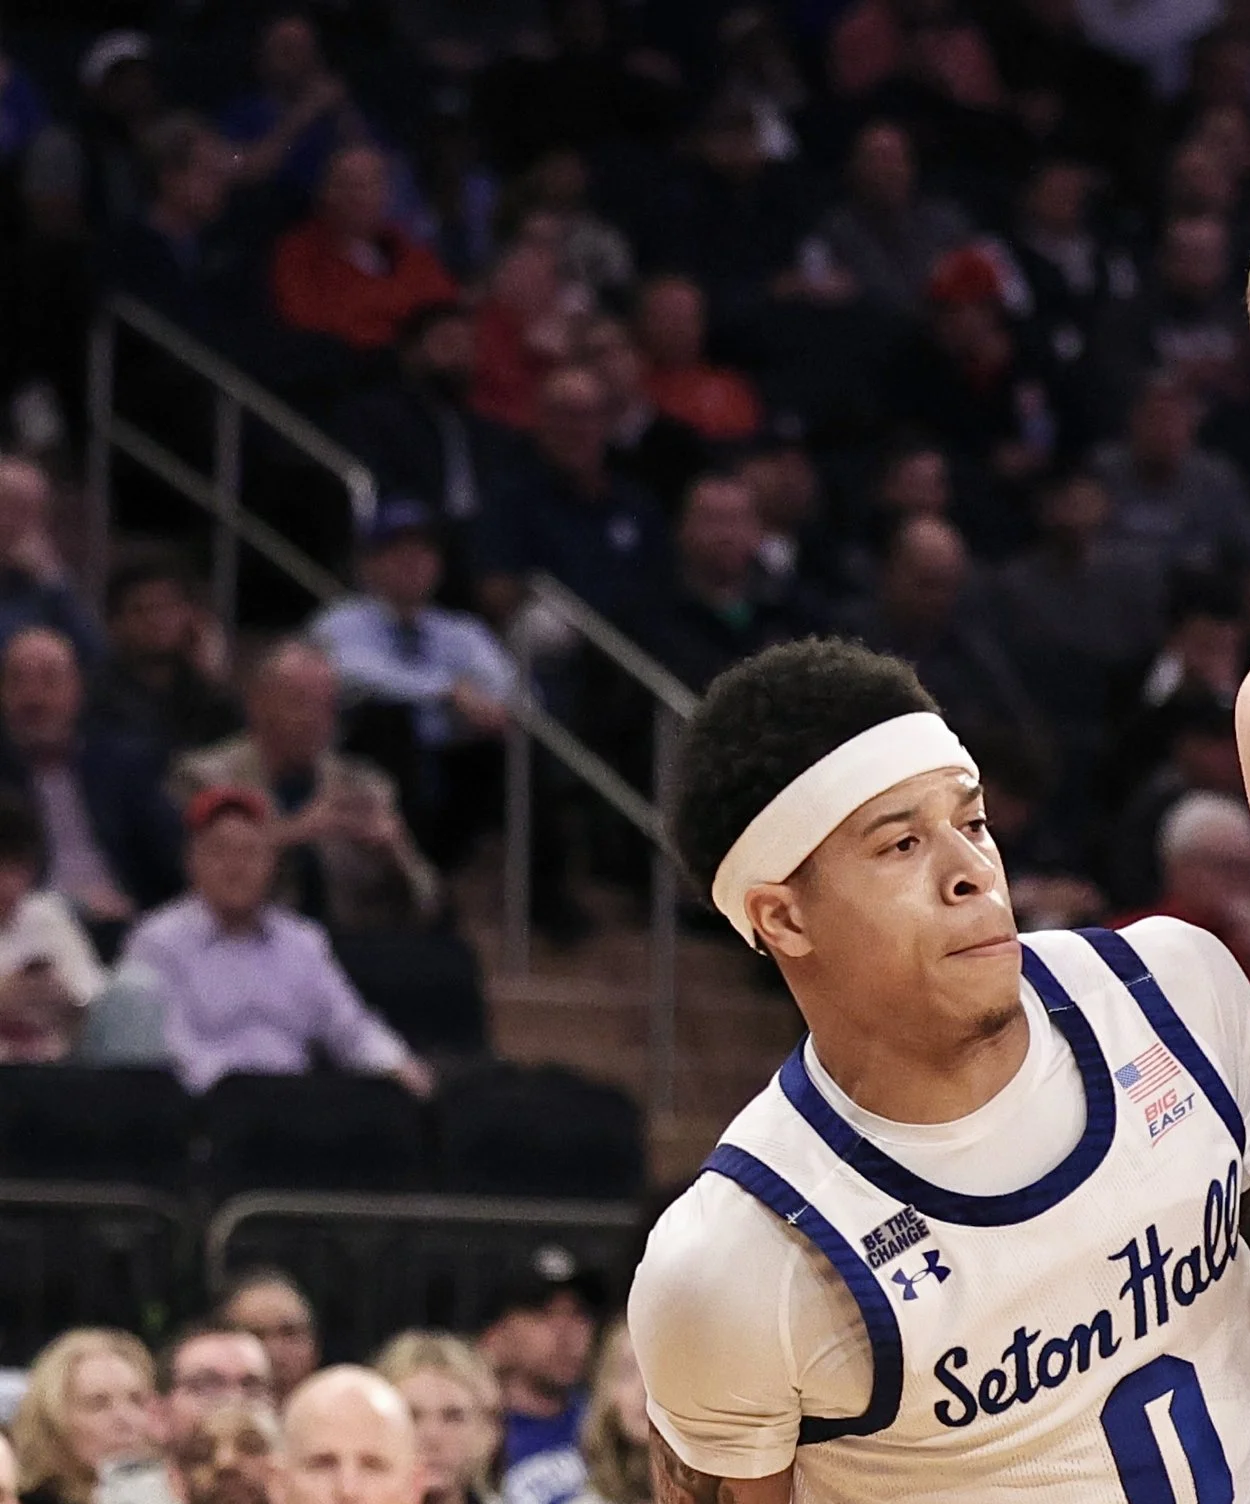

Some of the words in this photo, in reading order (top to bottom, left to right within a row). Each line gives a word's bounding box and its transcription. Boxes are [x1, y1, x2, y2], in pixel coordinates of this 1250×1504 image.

[1145, 1088, 1178, 1122] BIG
[1149, 1092, 1195, 1138] EAST
[862, 1227, 886, 1251] BE
[885, 1206, 917, 1236] THE
[867, 1218, 930, 1269] CHANGE
[933, 1308, 1122, 1428] Seton
[1108, 1159, 1242, 1340] Hall
